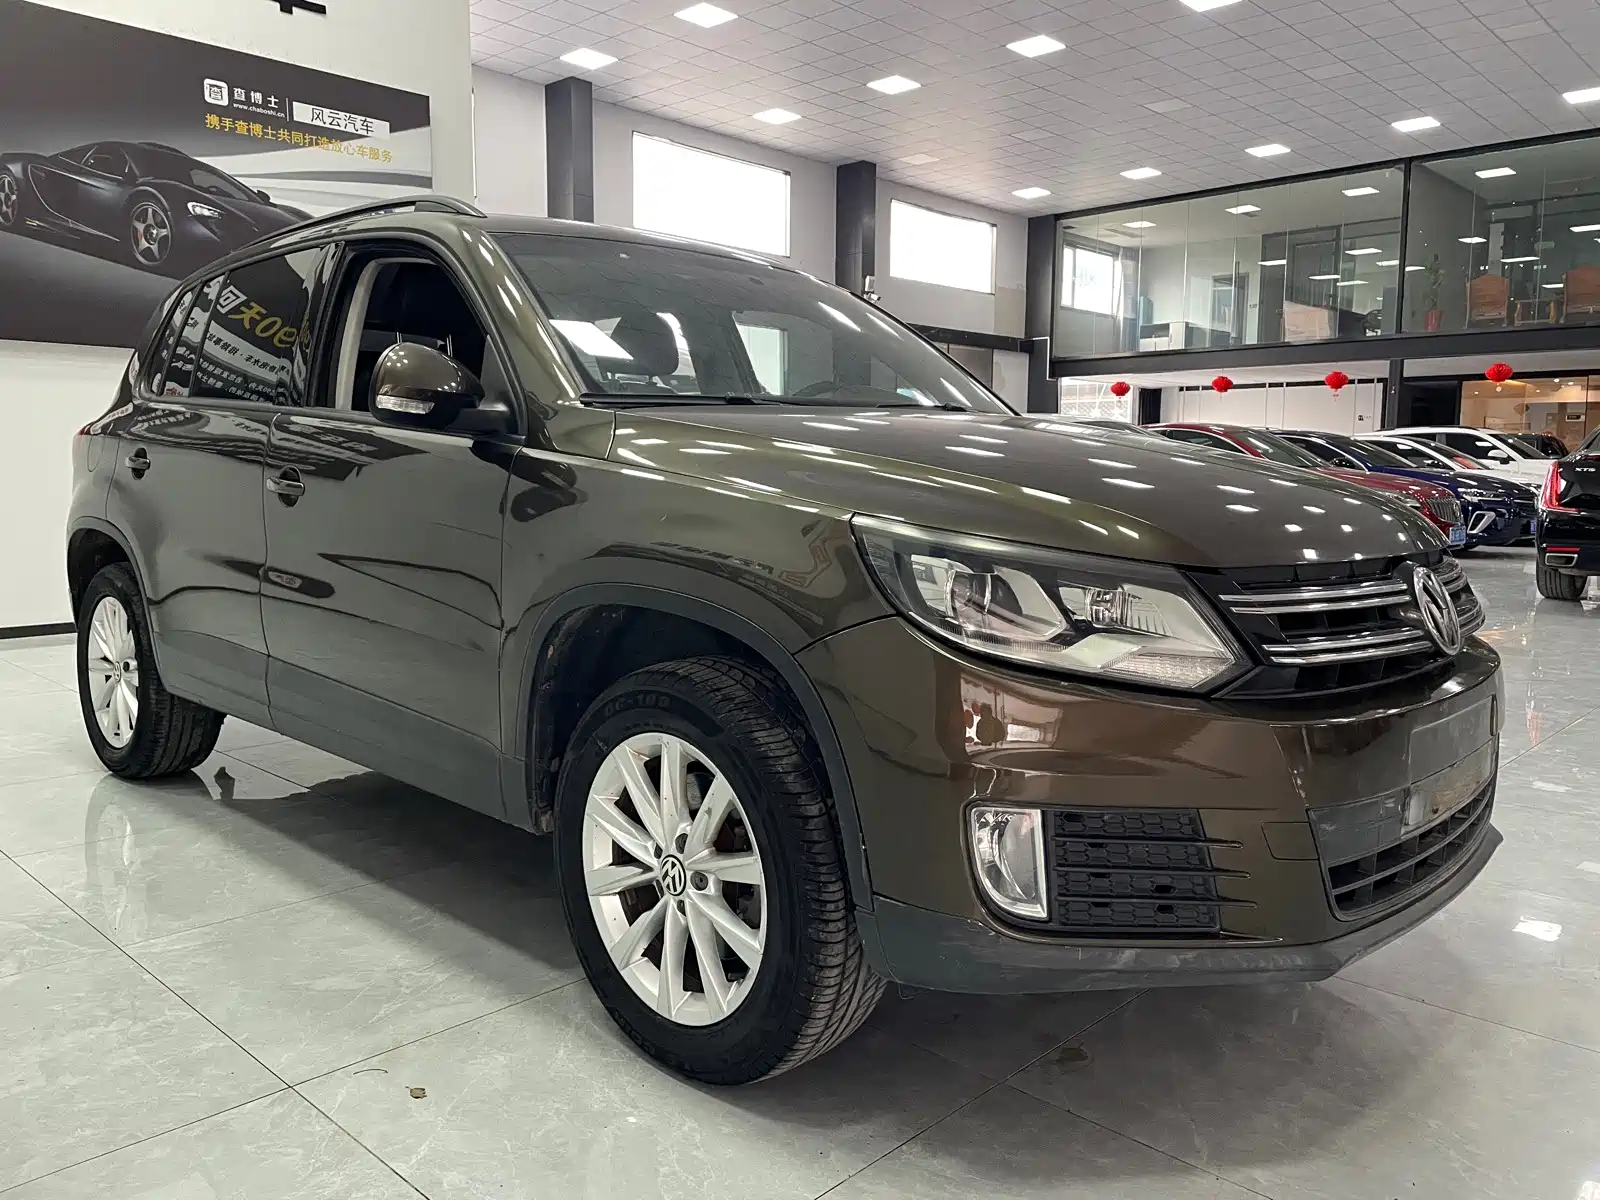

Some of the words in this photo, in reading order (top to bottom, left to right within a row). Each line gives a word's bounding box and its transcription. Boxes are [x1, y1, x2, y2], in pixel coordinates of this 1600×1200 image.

[233, 87, 279, 108] 查博士
[233, 103, 286, 118] www.chaboshi.cn
[311, 107, 374, 134] 风云汽车
[204, 113, 392, 162] 携手查博士共同打造放心车服务
